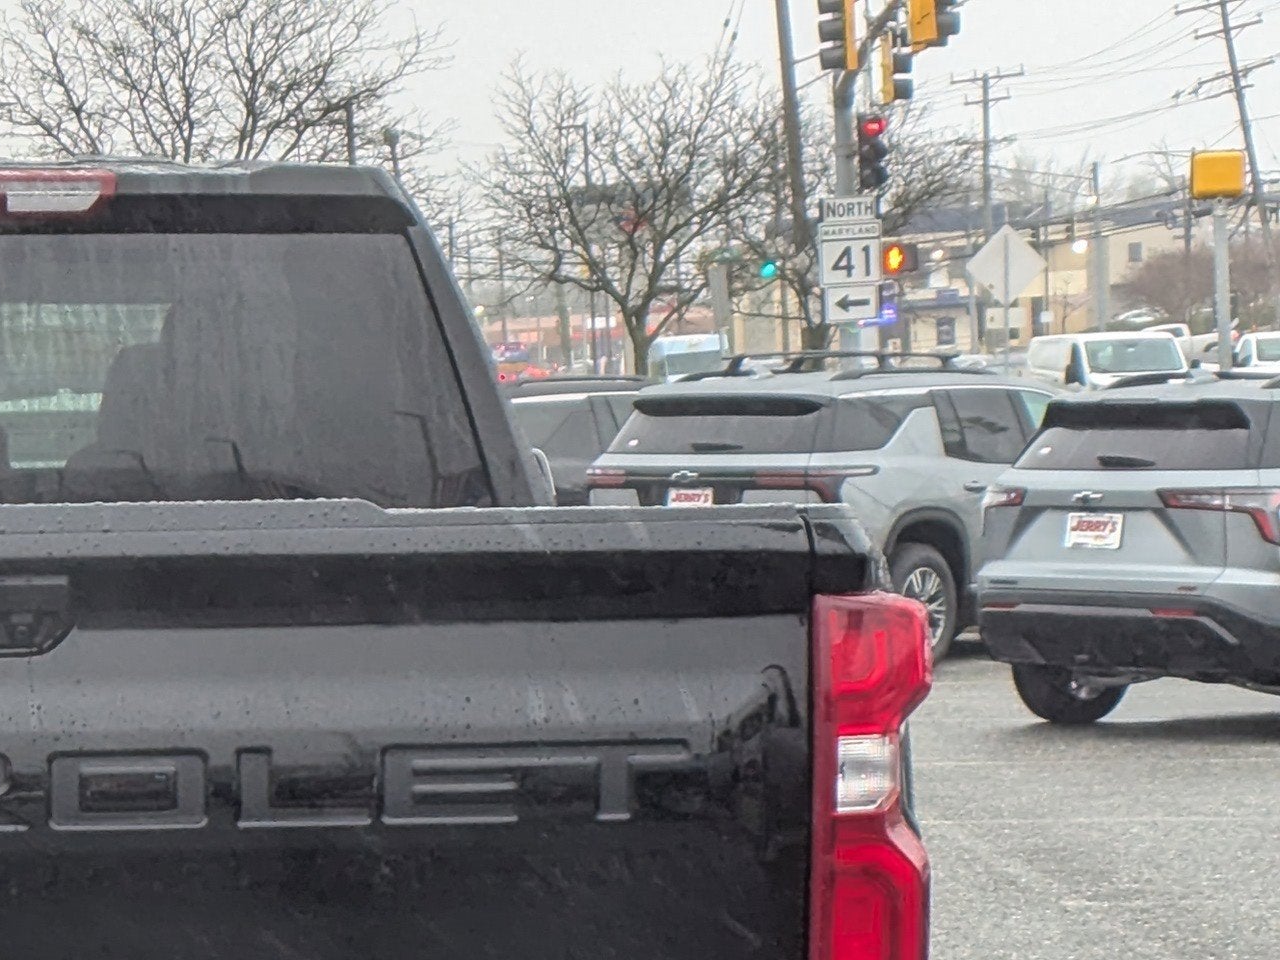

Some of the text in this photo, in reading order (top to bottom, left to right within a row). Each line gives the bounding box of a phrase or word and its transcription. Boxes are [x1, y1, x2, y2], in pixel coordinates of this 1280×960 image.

[825, 201, 875, 218] NORTH
[823, 225, 878, 236] MARYLAND
[831, 244, 871, 278] 41
[1070, 519, 1119, 534] JERRY'S
